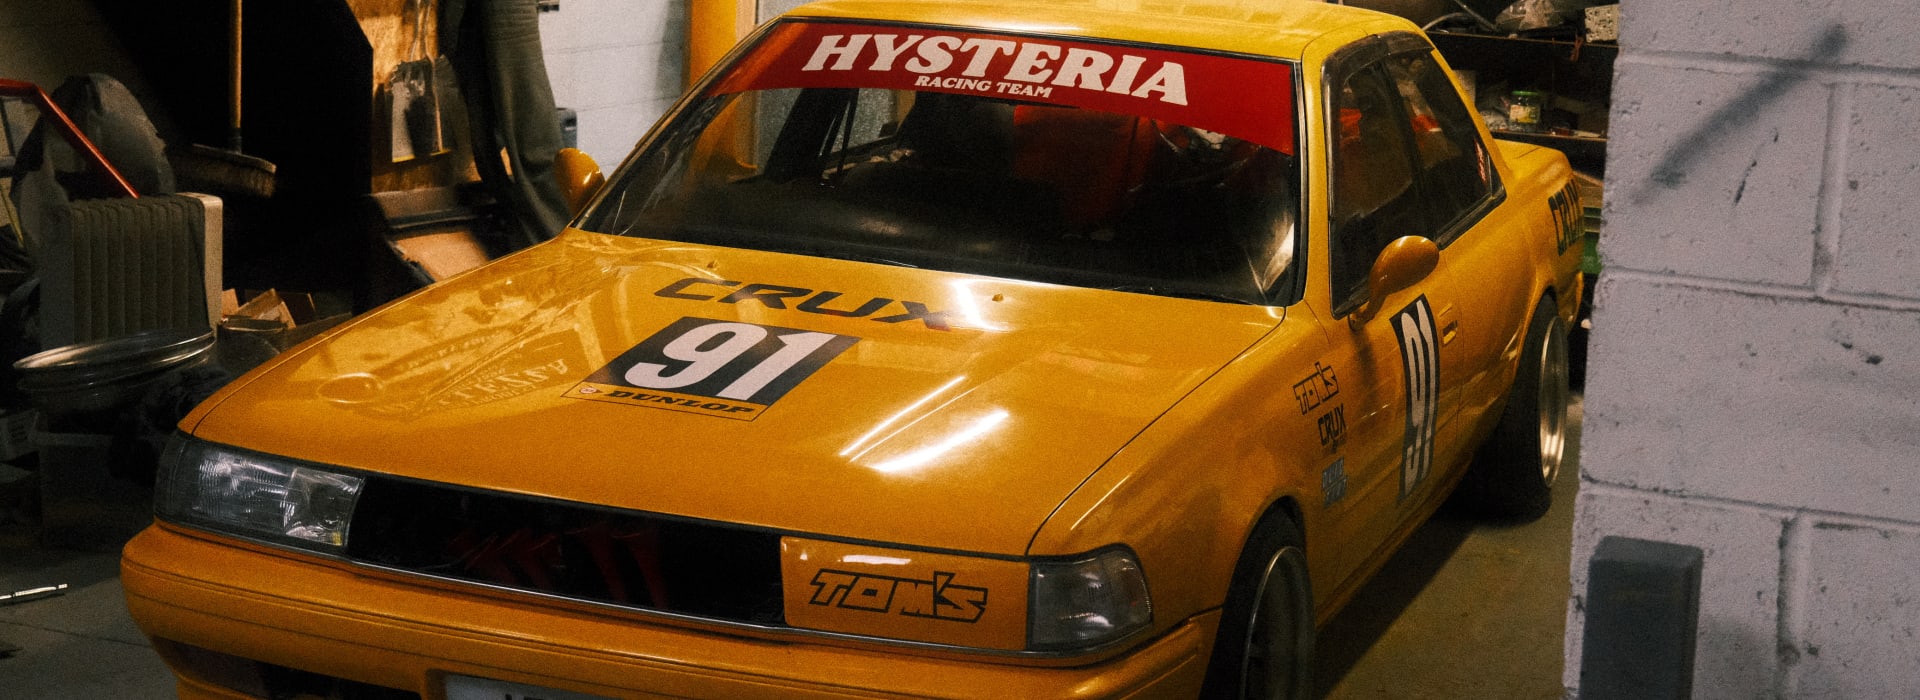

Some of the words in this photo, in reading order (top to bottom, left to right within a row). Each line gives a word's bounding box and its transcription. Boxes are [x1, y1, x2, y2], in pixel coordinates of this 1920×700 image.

[802, 33, 1188, 106] HYSTERIA
[914, 75, 992, 92] RACING
[997, 81, 1053, 99] TEAM
[654, 277, 951, 331] CRUX
[624, 323, 838, 401] 91
[604, 390, 755, 413] DUNLOP
[1317, 403, 1347, 446] CRUX
[1401, 300, 1436, 497] 91
[809, 568, 989, 624] TOM'S
